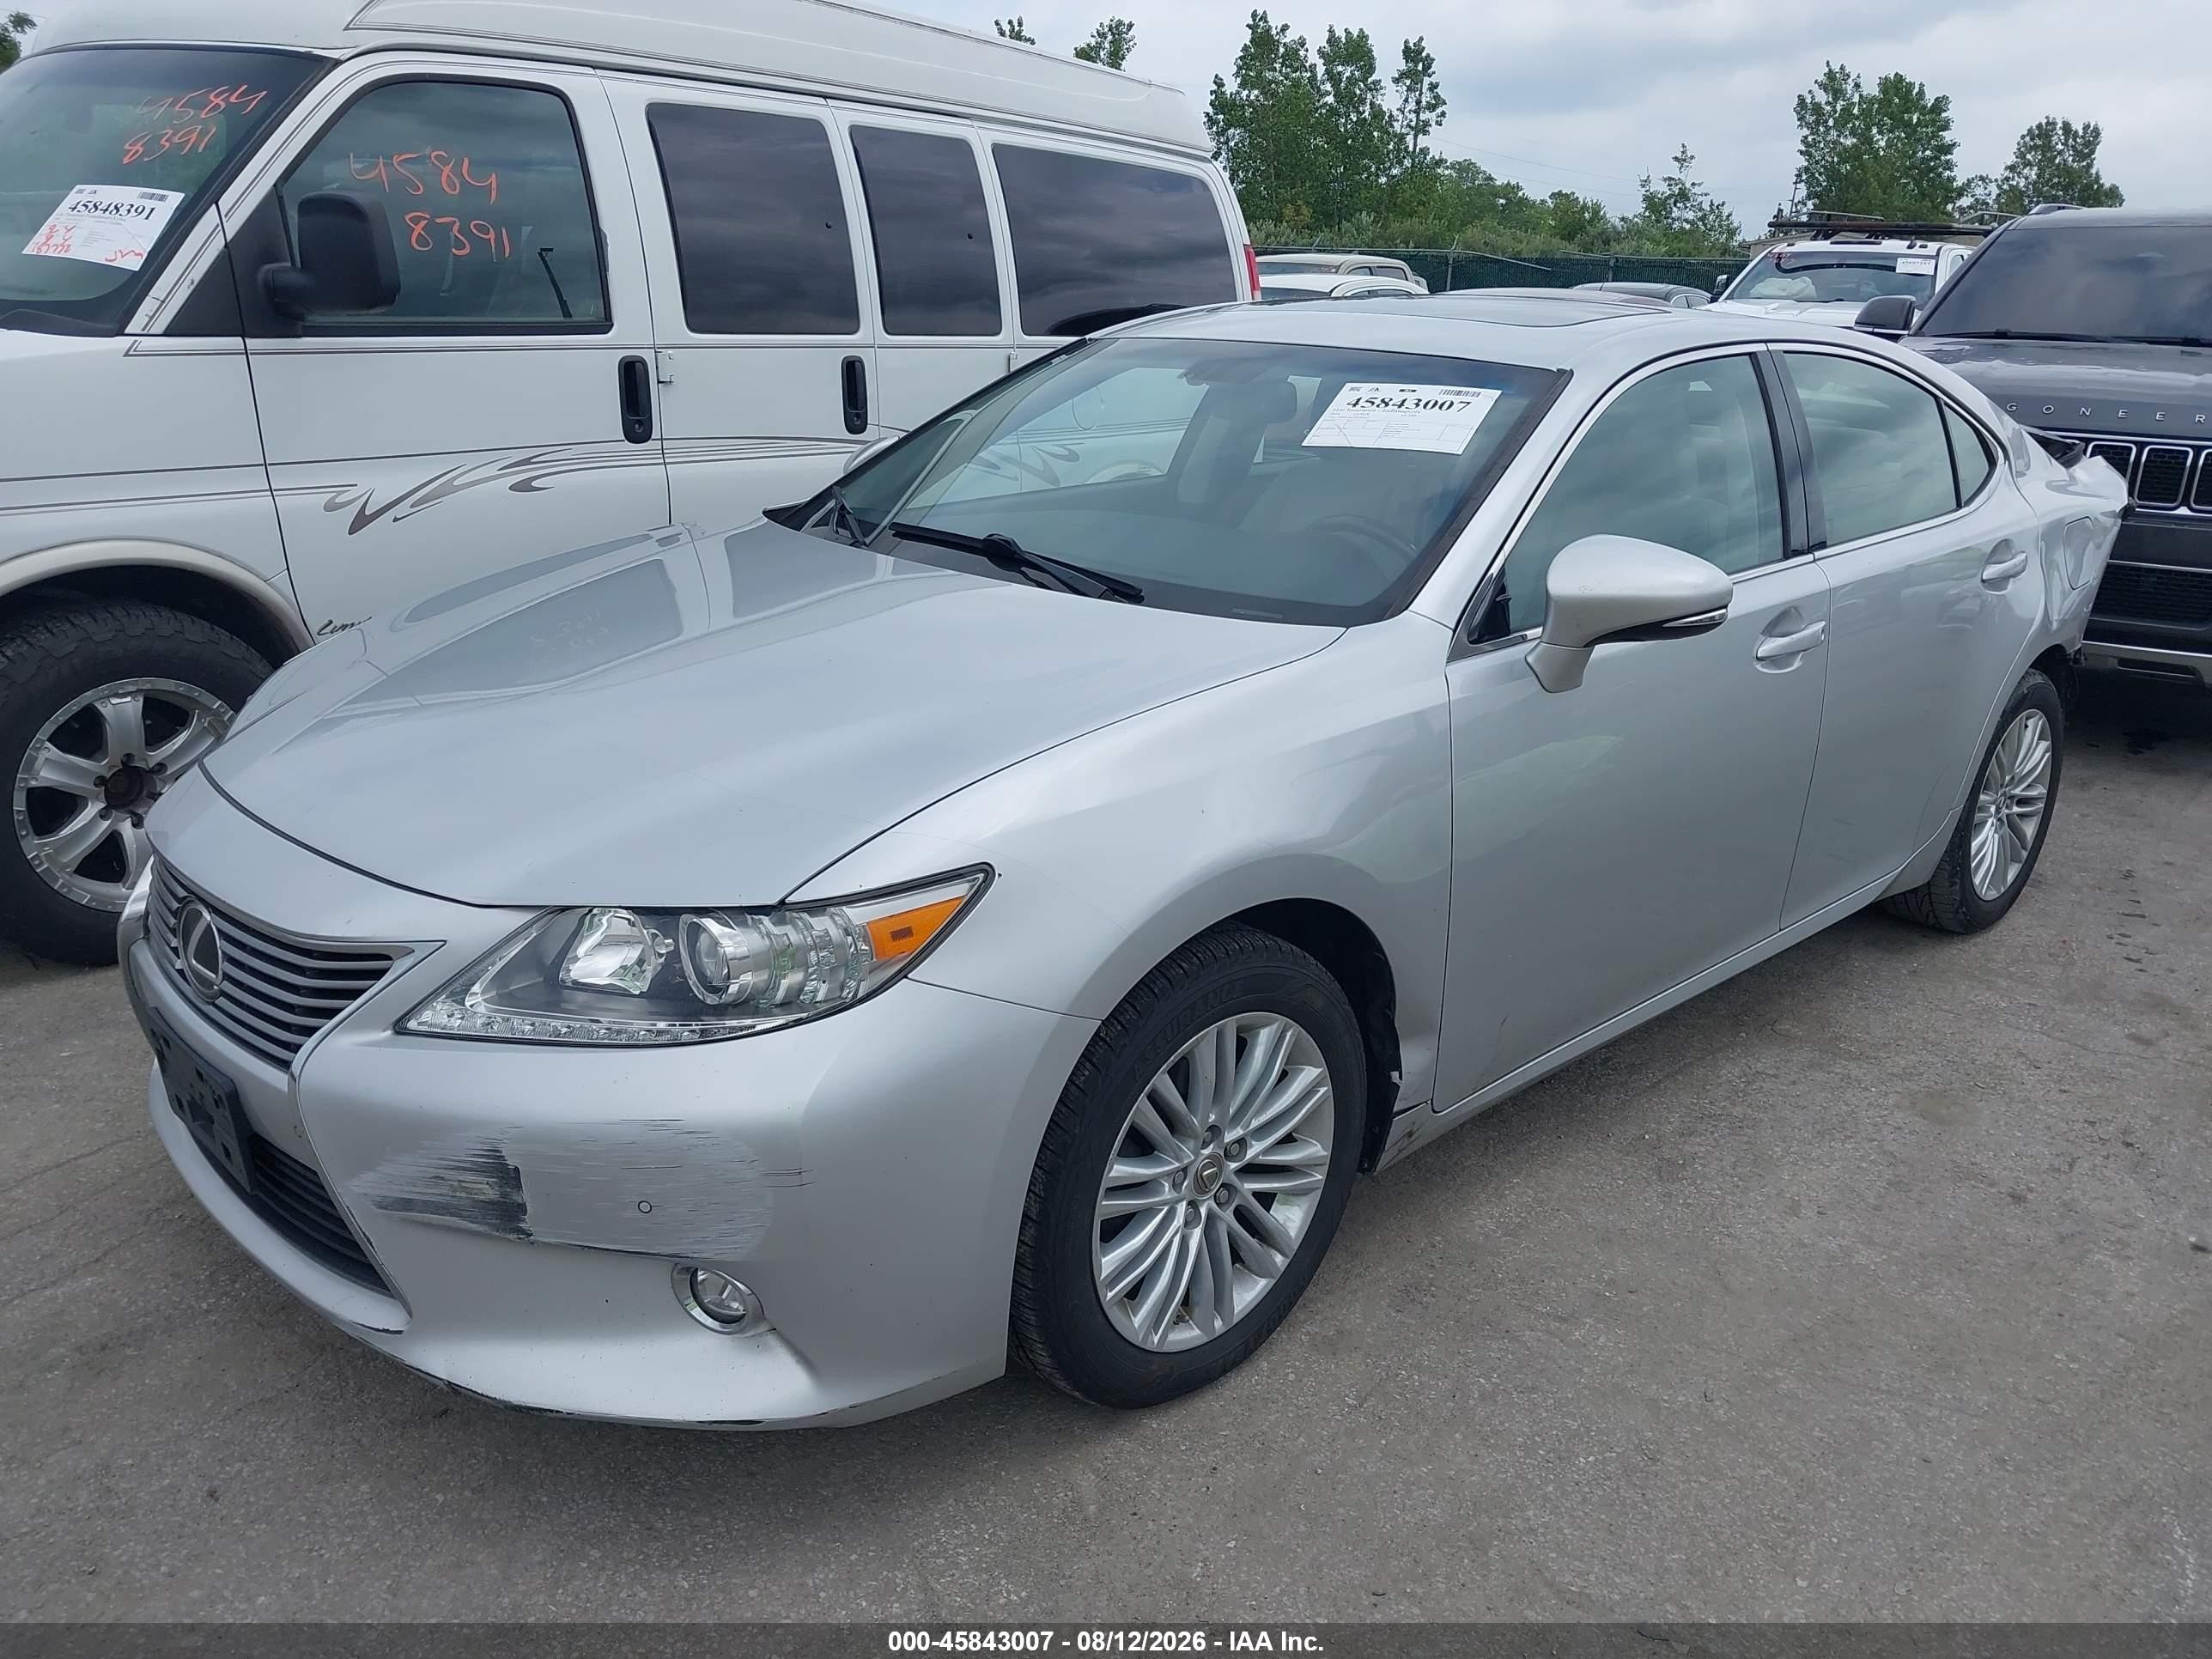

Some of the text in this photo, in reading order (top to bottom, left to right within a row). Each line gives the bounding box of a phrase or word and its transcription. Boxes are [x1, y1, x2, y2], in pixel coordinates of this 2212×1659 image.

[137, 85, 267, 124] 4584
[123, 125, 216, 165] 8391
[349, 150, 496, 205] 4584
[68, 199, 156, 221] 45848391
[404, 211, 510, 261] 8391
[1346, 396, 1473, 413] 45843007
[2006, 402, 2207, 424] GONEER
